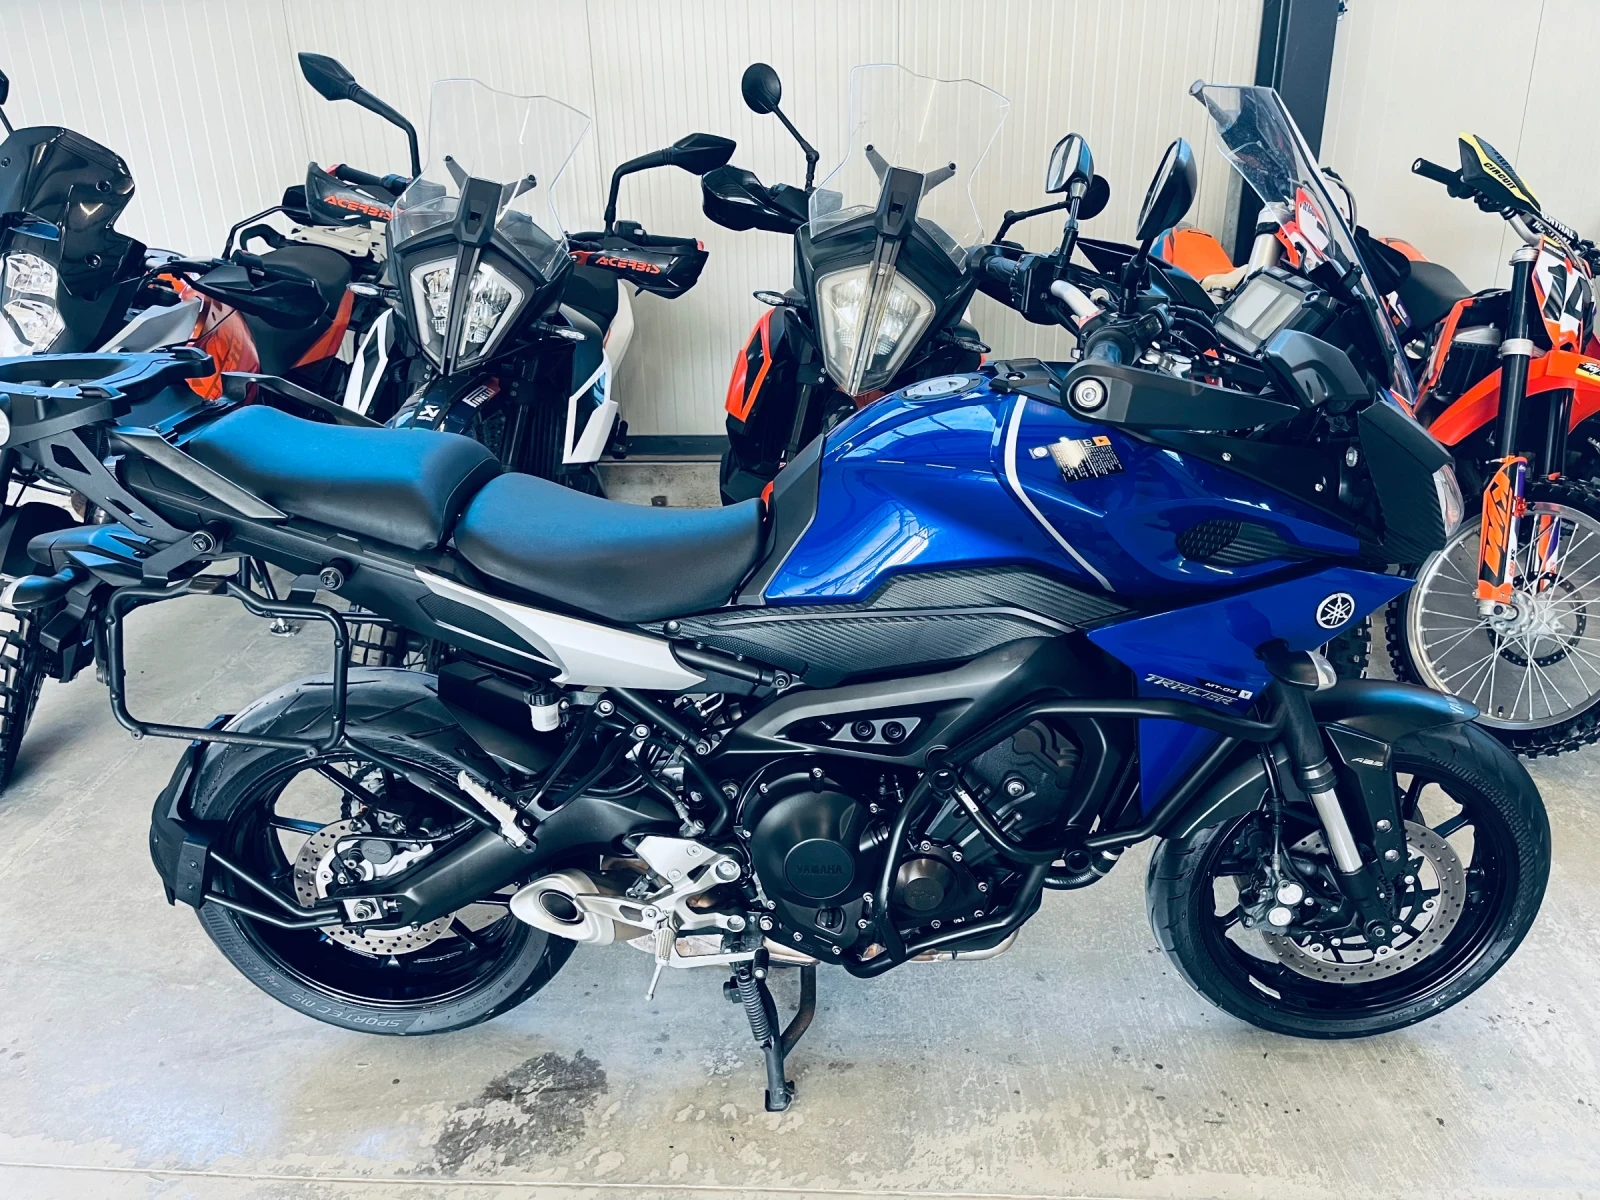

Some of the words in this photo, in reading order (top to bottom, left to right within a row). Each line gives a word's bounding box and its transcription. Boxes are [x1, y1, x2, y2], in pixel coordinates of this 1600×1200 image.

[1483, 161, 1517, 190] CIRCUIT
[323, 194, 393, 221] ACERBIS
[595, 256, 661, 275] ACERBIS
[462, 384, 496, 408] PIRELLI
[1205, 682, 1238, 694] MT-09
[796, 863, 843, 875] YAMAHA
[316, 1005, 404, 1028] SPORTEC
